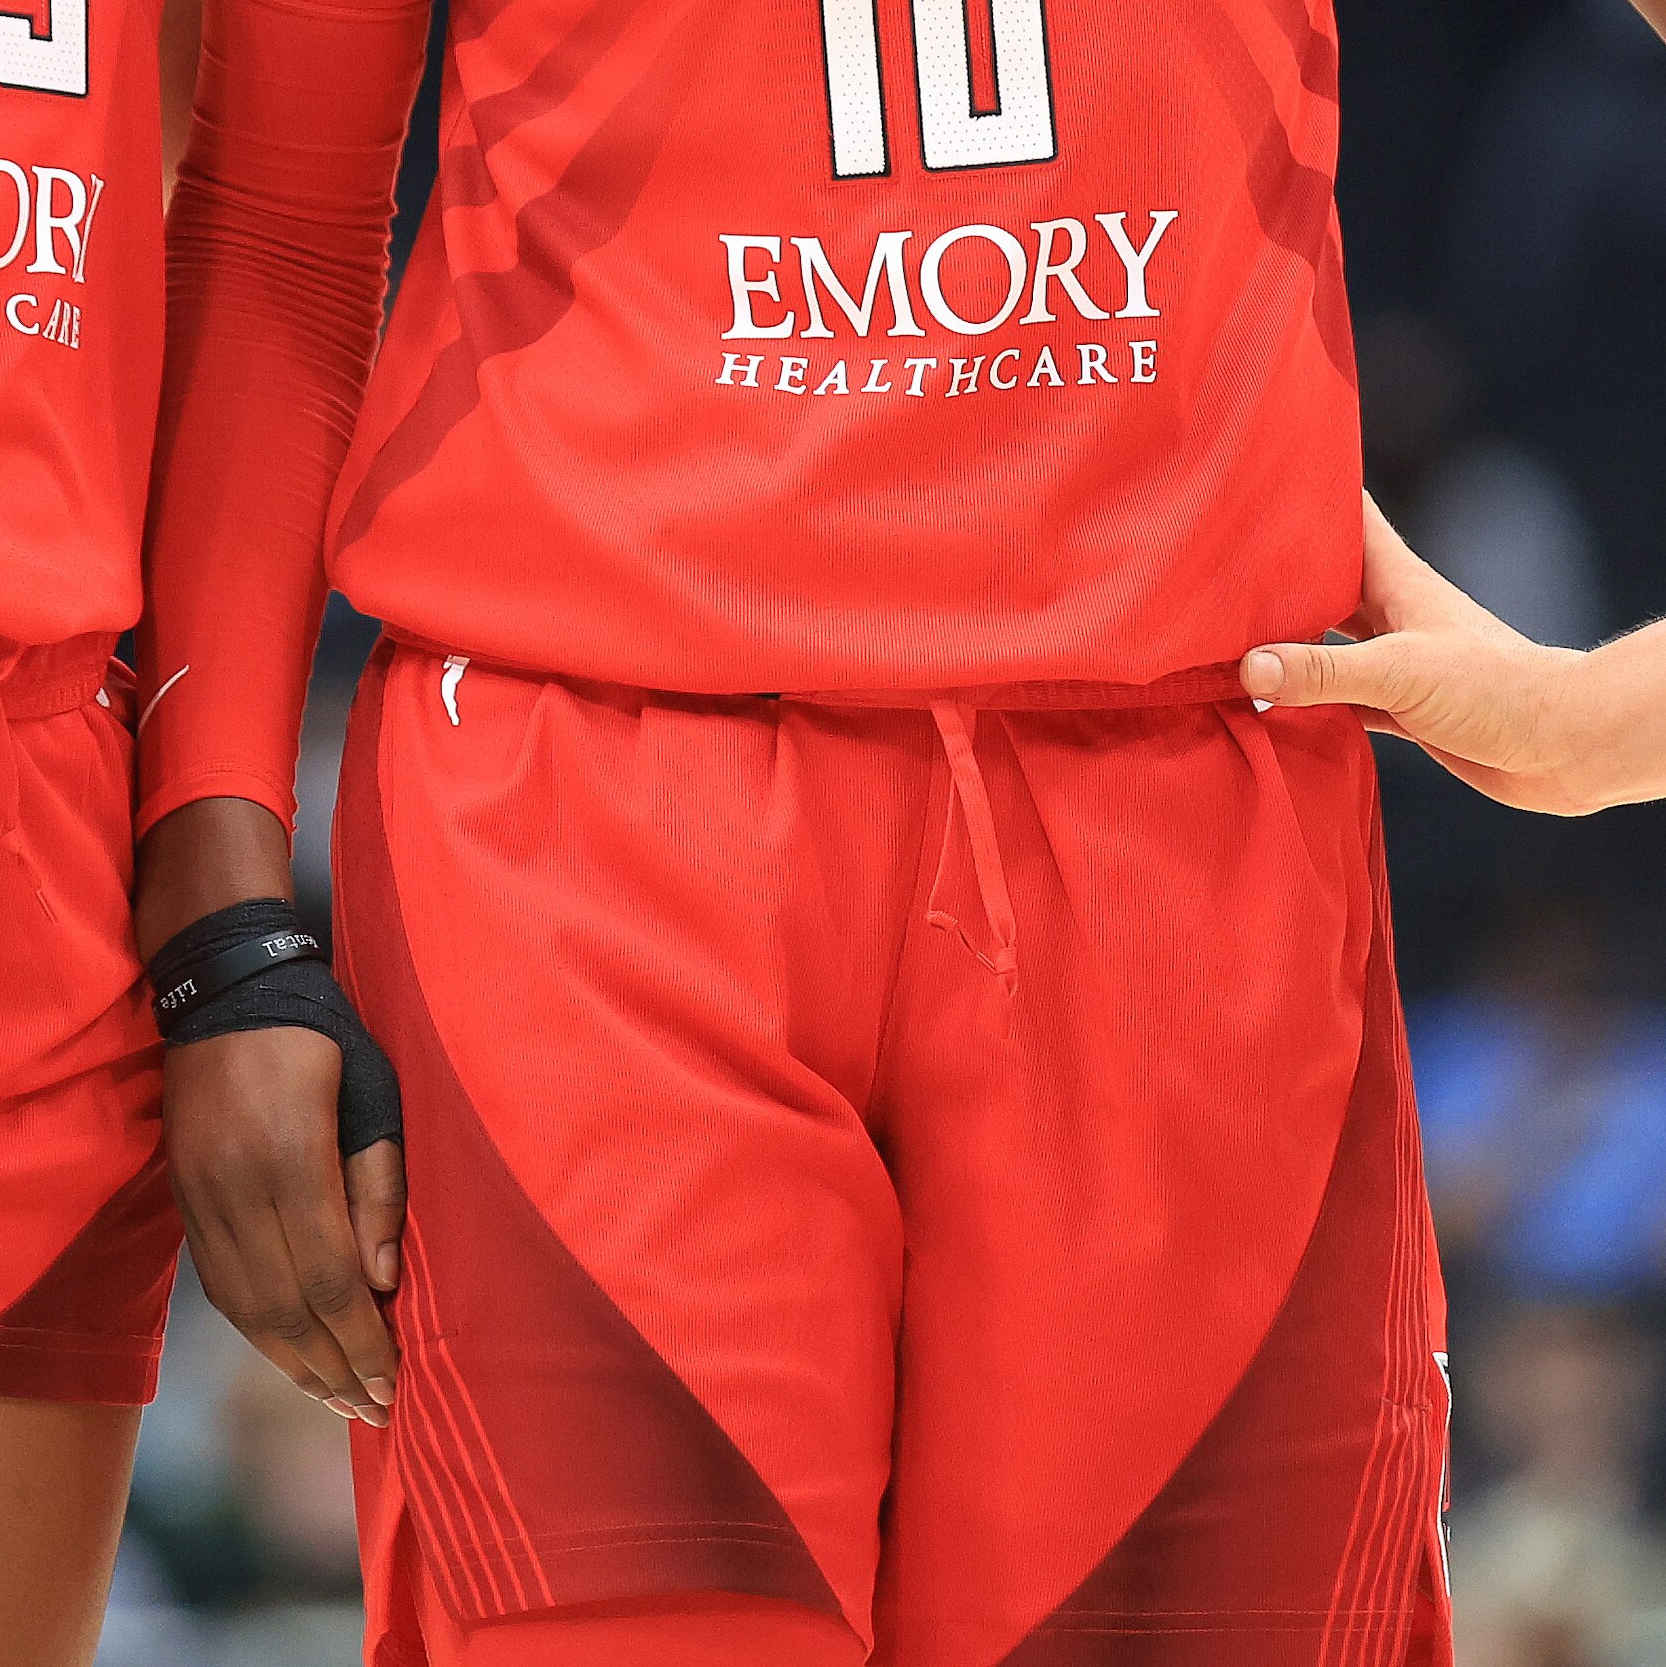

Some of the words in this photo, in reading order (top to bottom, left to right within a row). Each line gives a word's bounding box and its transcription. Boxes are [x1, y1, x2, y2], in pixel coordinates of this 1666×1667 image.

[717, 210, 1180, 341] EMORY
[715, 340, 1159, 399] HEALTHCARE
[261, 934, 320, 958] ental
[160, 978, 198, 1010] Life
